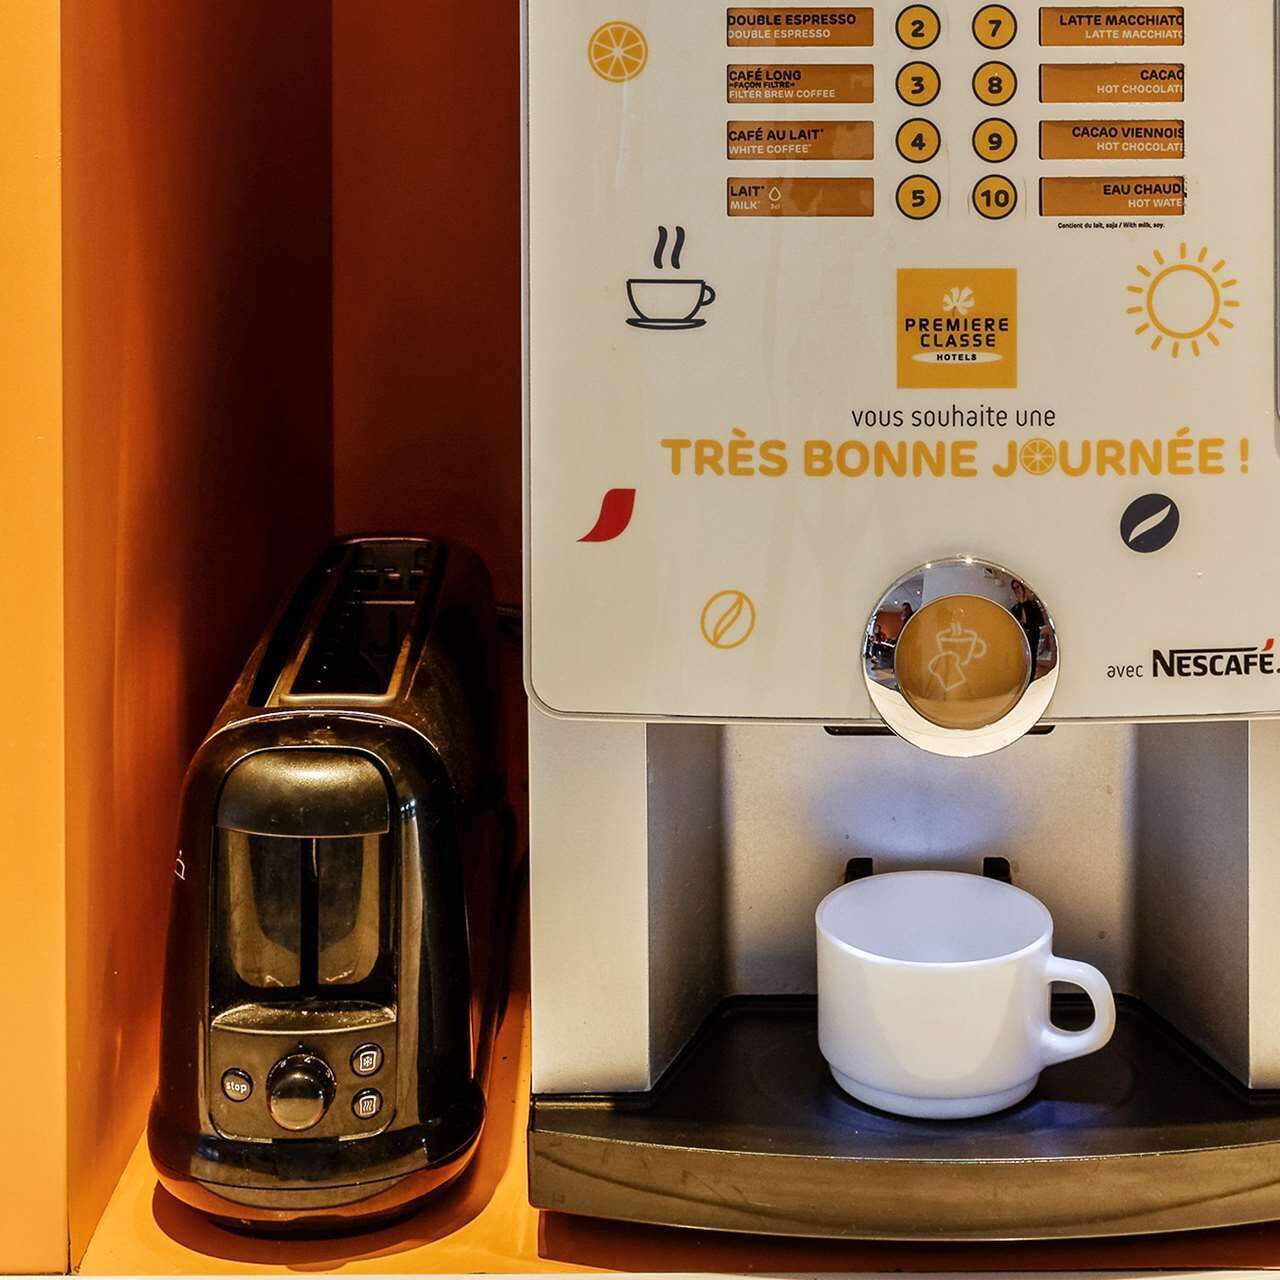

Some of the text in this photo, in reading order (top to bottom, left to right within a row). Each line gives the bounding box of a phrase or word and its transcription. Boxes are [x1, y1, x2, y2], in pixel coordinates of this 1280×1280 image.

[728, 14, 856, 26] DOUBLE ESPRESSO
[1060, 15, 1102, 26] LATTE
[728, 29, 831, 39] DOUBLE ESPRESSO
[910, 20, 925, 37] 2
[987, 20, 1002, 37] 7
[1085, 30, 1119, 39] LATTE
[729, 68, 801, 81] CAFÉ LONG
[910, 76, 925, 94] 3
[987, 76, 1003, 94] 8
[1097, 85, 1120, 94] HOT
[729, 90, 835, 99] FILTER BREW COFFEE
[729, 127, 763, 141] CAFÉ
[767, 129, 786, 140] AU
[1072, 127, 1184, 138] CACAO VIENNOIS
[910, 134, 926, 151] 4
[987, 134, 1002, 151] 9
[1097, 142, 1120, 151] HOT
[729, 145, 764, 154] WHITE
[1103, 184, 1184, 195] EAU CHAUD
[910, 190, 925, 208] 5
[980, 190, 1010, 208] 10
[1128, 199, 1183, 208] HOT WATE
[905, 317, 1010, 333] PREMIERE
[919, 333, 996, 348] CLASSE
[936, 353, 977, 362] HOTELS
[851, 404, 1056, 428] vous souhaite une
[660, 428, 787, 476] TRÈS
[803, 440, 978, 478] BONNE
[1238, 437, 1249, 474] !
[1106, 661, 1144, 679] avec
[226, 1081, 248, 1093] stop
